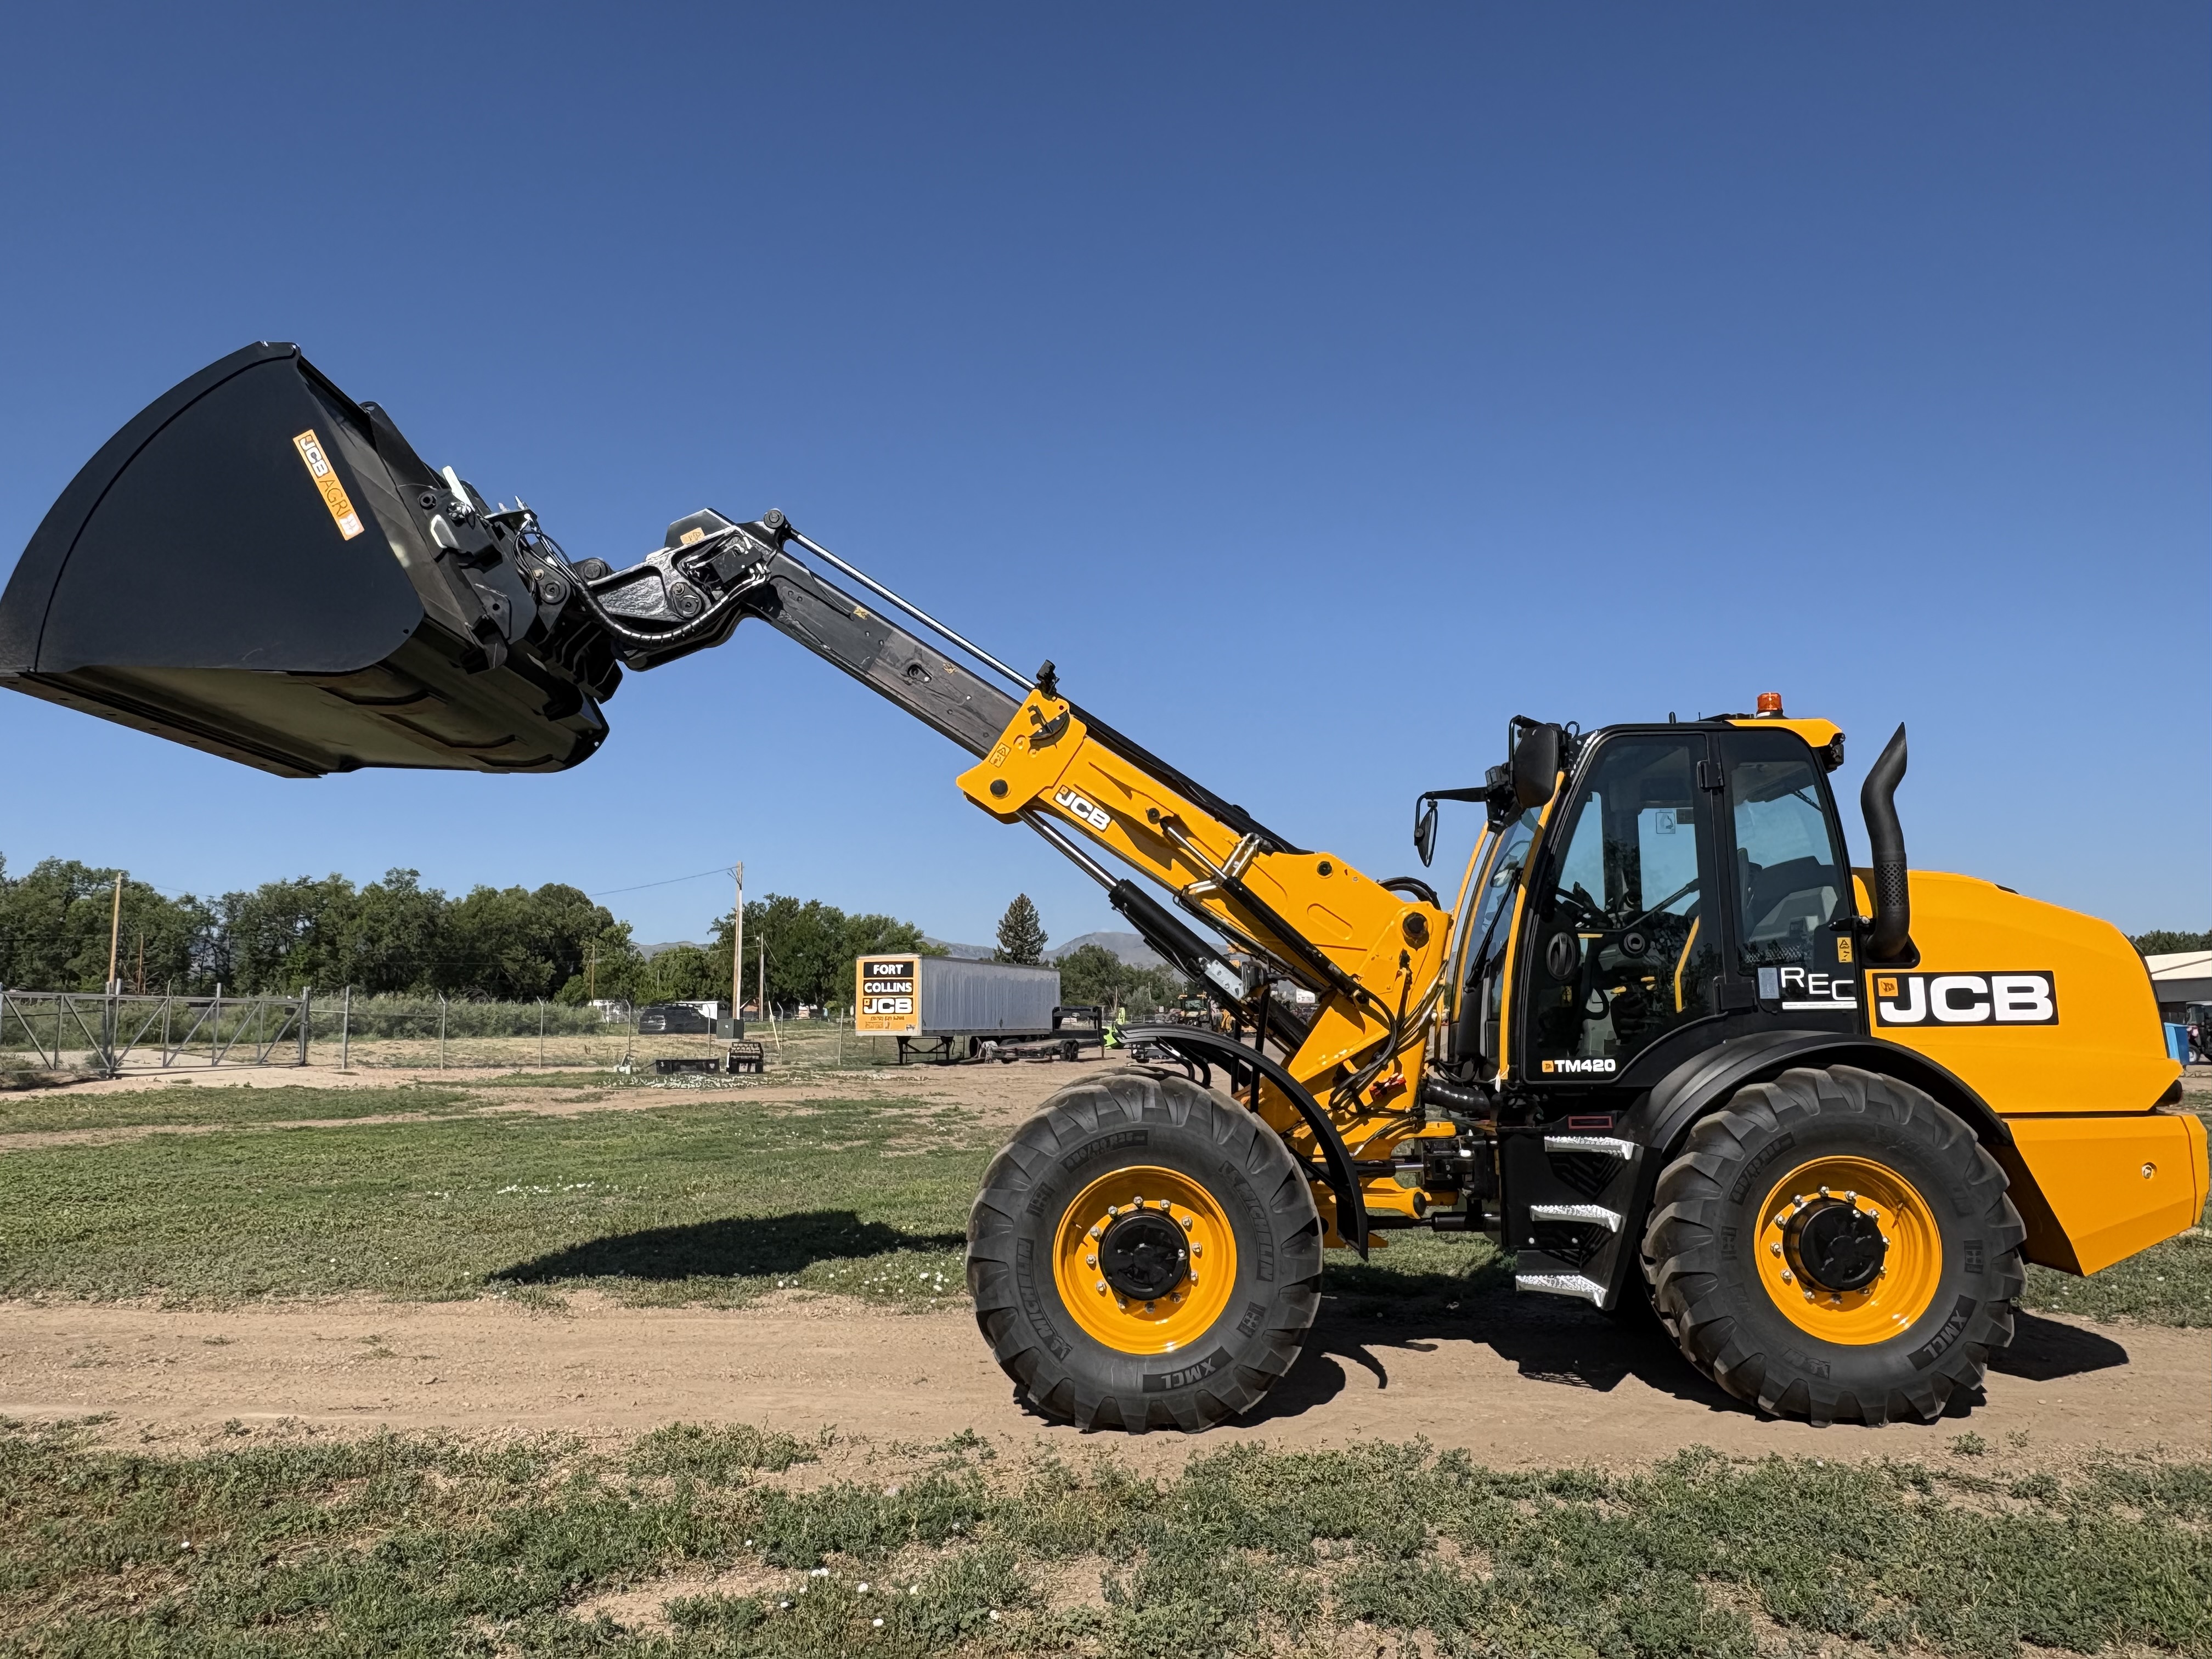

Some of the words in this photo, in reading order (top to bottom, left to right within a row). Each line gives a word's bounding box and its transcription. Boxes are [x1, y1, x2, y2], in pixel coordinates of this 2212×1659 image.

[300, 437, 330, 477] JCB
[319, 479, 351, 518] AGRI
[1055, 791, 1111, 831] JCB
[873, 964, 904, 975] FORT
[1780, 967, 1856, 1001] REC
[864, 982, 913, 993] COLLINS
[1879, 975, 2053, 1023] JCB
[863, 998, 913, 1014] JCB
[1554, 1059, 1616, 1073] TM420
[1017, 1237, 1056, 1338] MICHELIN
[1922, 1310, 1967, 1358] XMCL
[1161, 1357, 1216, 1389] XMCL
